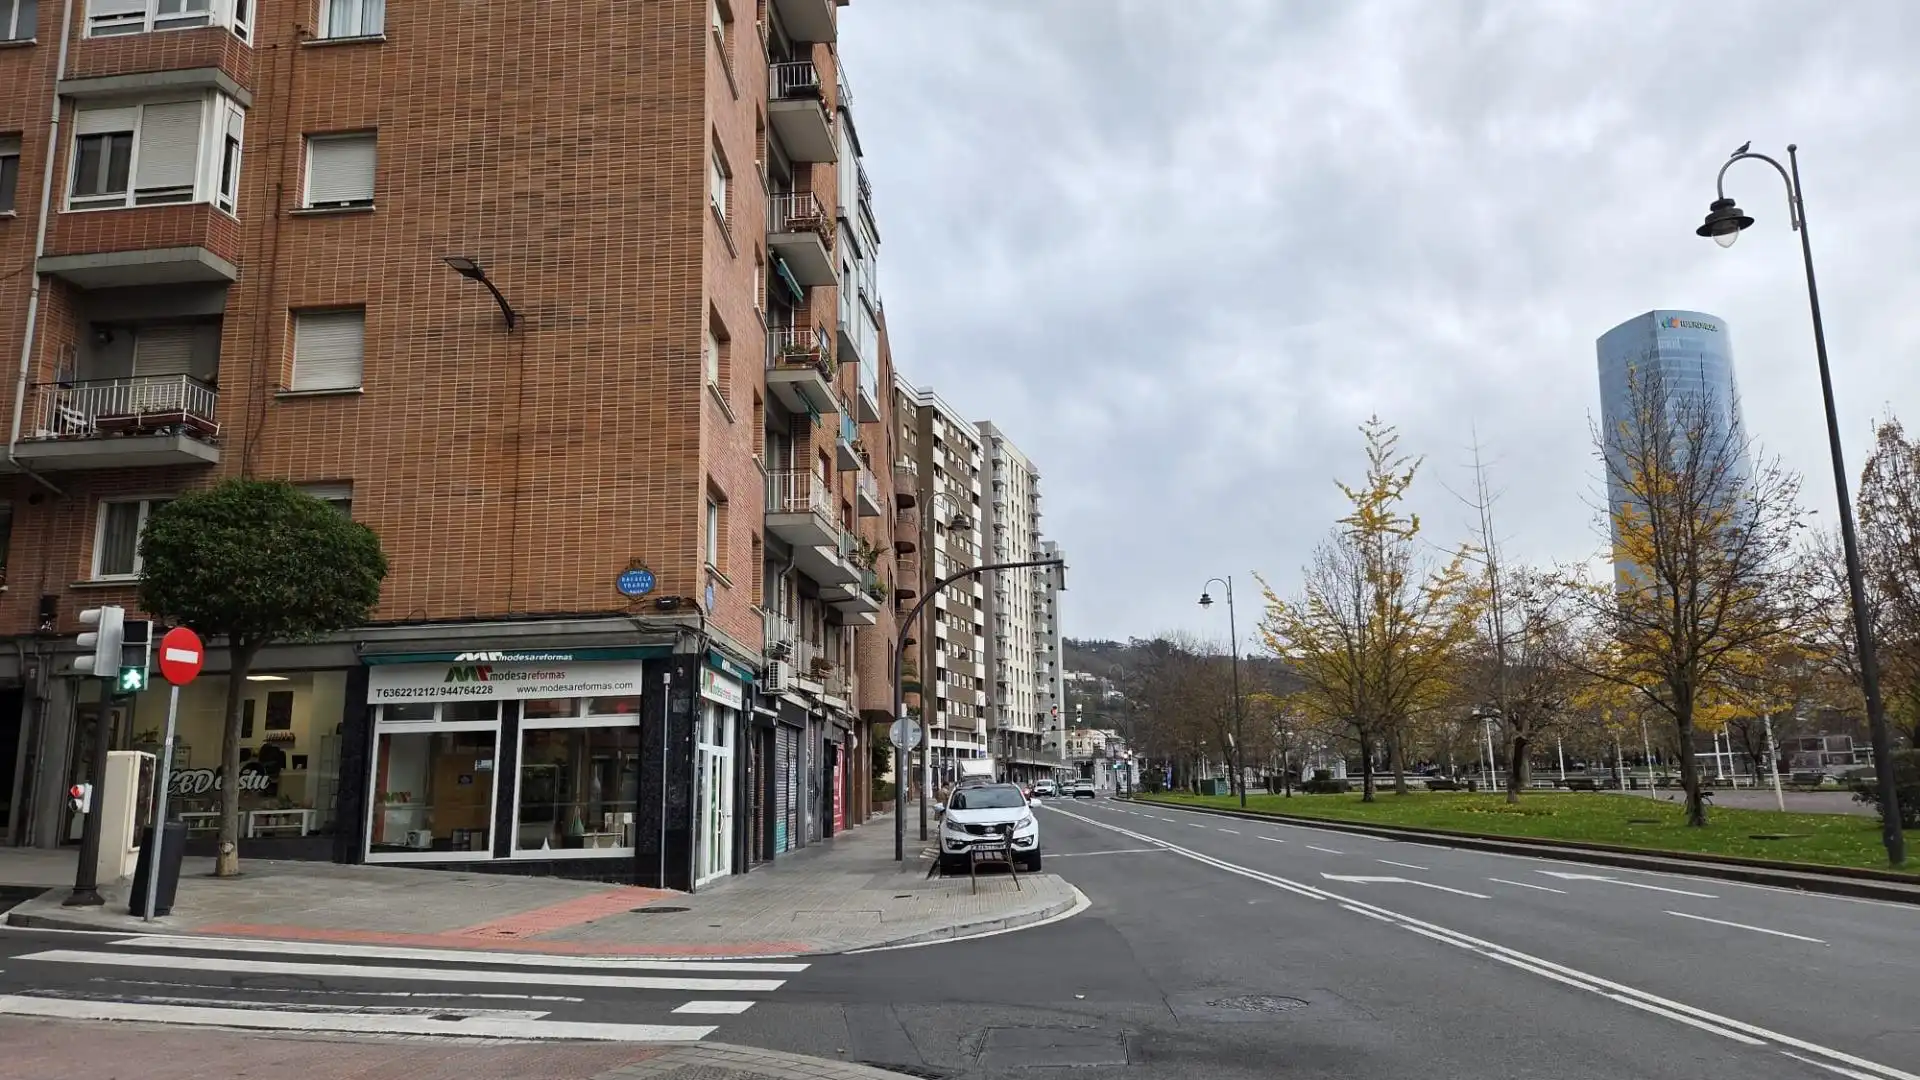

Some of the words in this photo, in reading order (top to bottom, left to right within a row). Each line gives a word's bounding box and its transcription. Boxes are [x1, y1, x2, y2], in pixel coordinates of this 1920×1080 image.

[499, 653, 573, 662] modesareformas
[489, 670, 566, 682] modesareformas
[516, 681, 633, 694] www.modesareformas.com
